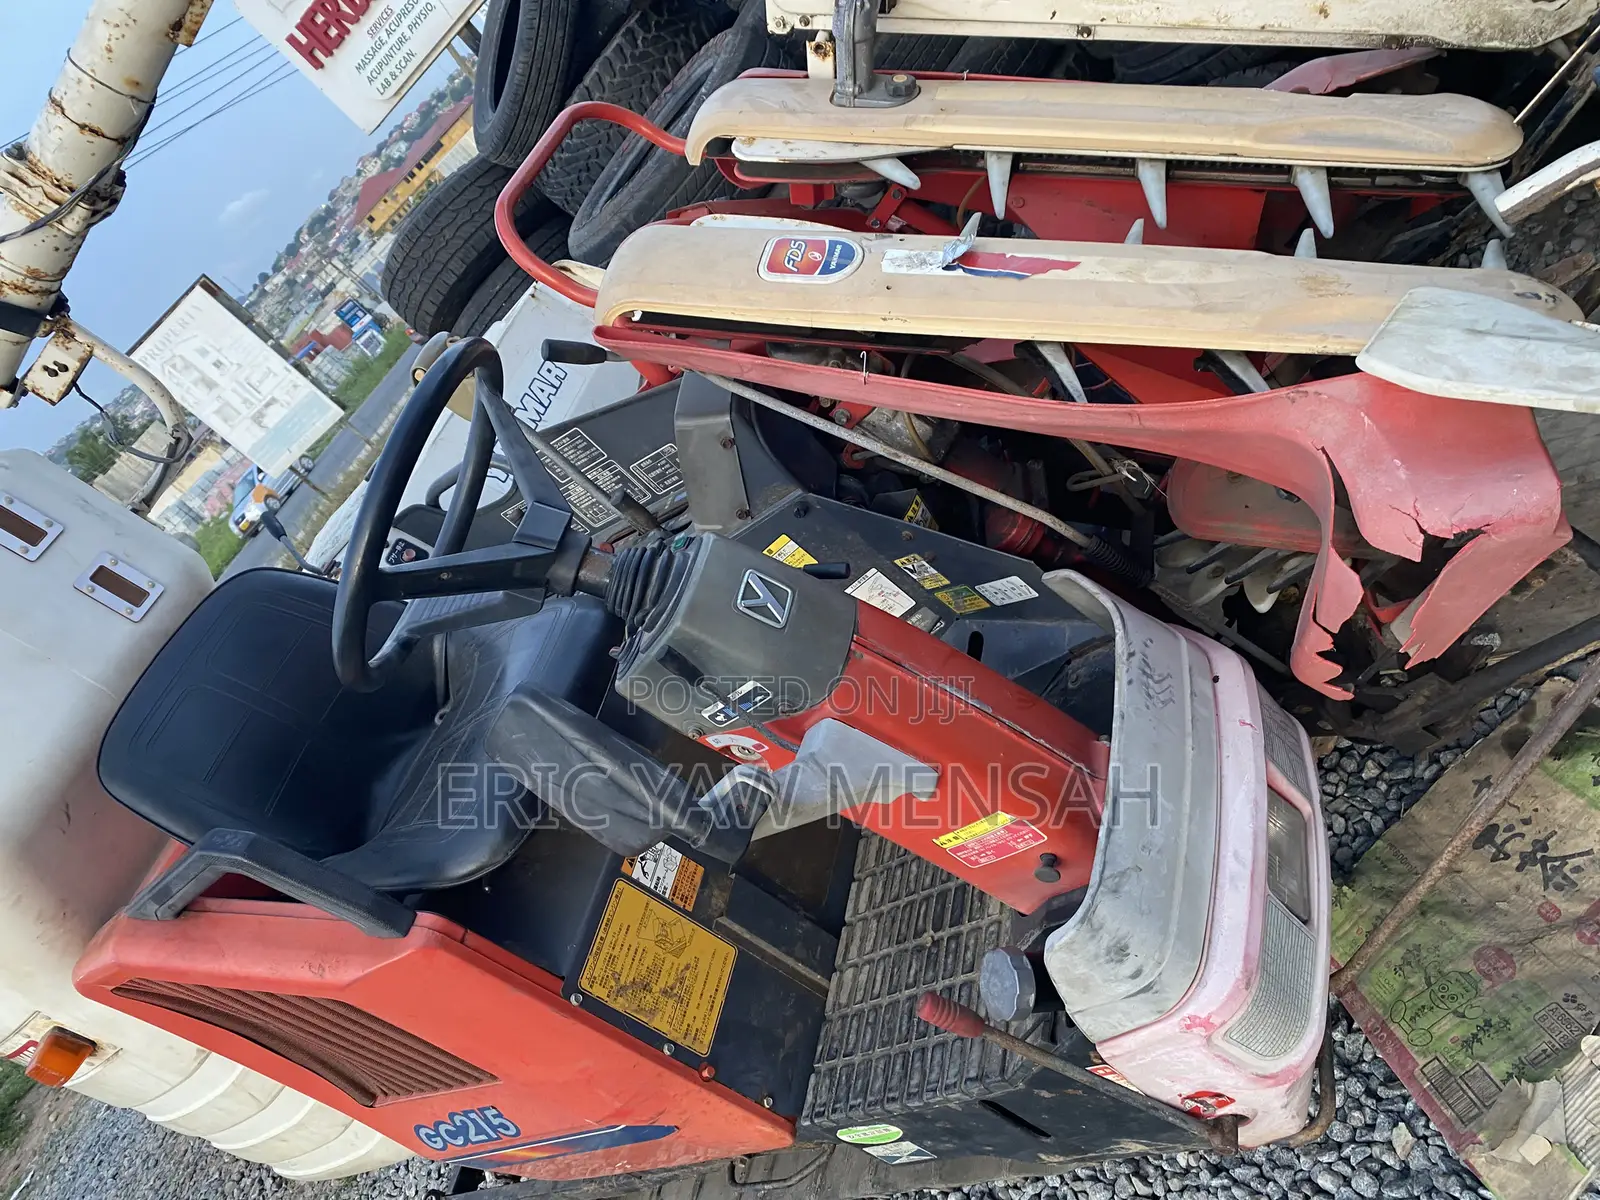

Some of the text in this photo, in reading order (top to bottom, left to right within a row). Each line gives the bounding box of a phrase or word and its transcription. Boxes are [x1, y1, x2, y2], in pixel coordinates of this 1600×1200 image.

[367, 5, 394, 39] SERVICES
[355, 37, 388, 75] MASSAGE,
[366, 2, 437, 86] ACUPUNTURE, PHYSIO,
[376, 49, 418, 95] LAB & SCAN.
[784, 240, 806, 272] FDS
[830, 244, 843, 270] YANMAR
[416, 1107, 520, 1150] GC215
